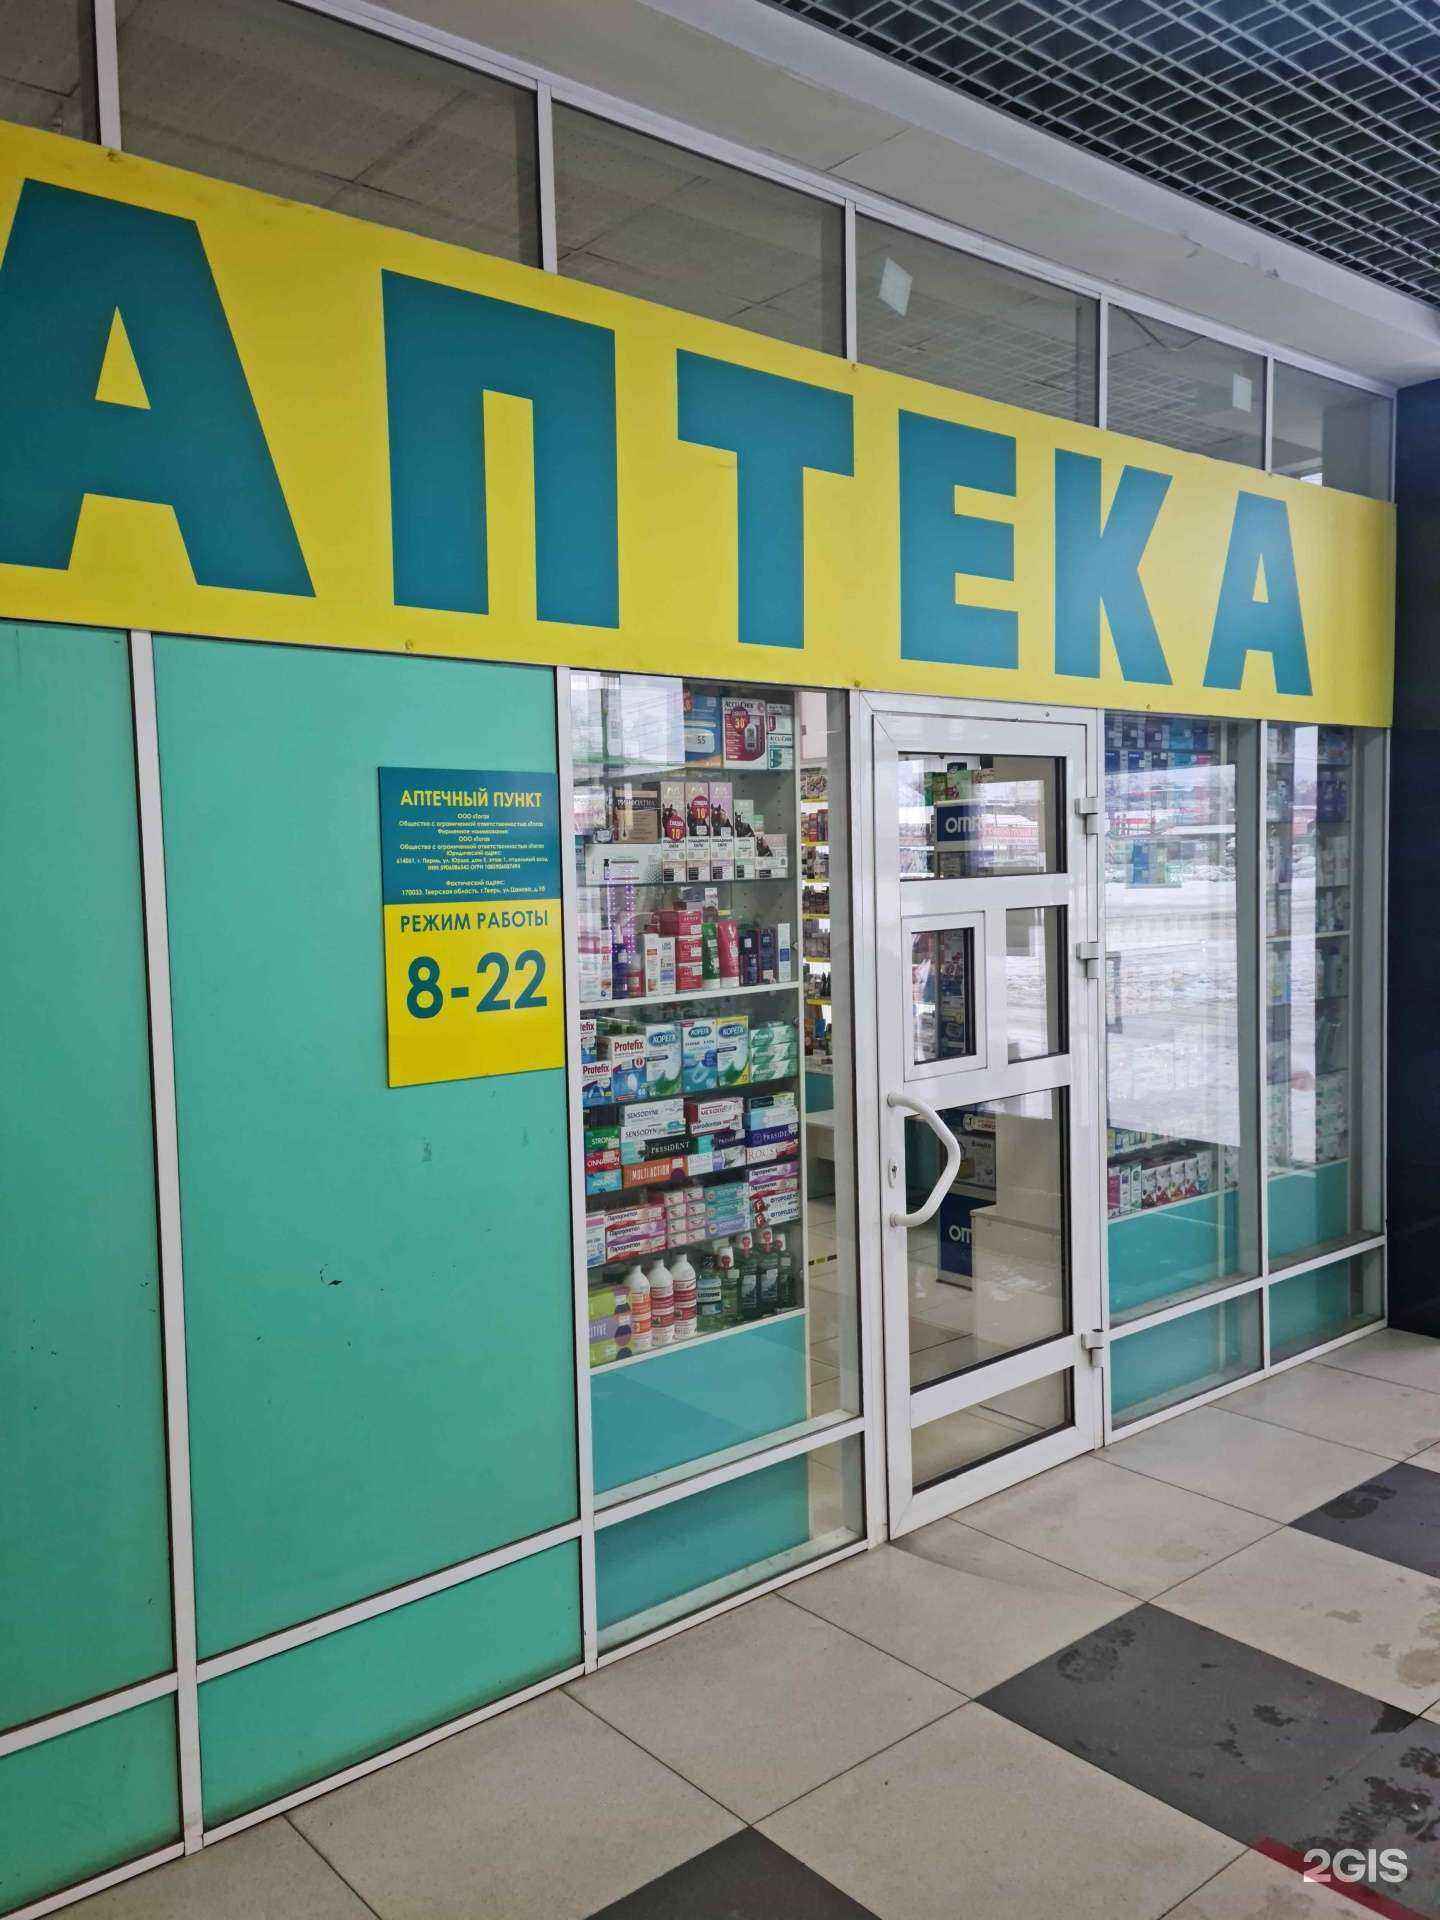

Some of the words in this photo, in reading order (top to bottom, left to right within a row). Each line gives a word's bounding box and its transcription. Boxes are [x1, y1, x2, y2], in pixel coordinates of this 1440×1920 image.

[0, 177, 1313, 697] АПТЕКА
[400, 787, 488, 807] АПТЕЧНЫЙ
[493, 791, 543, 808] ПУНКТ
[400, 911, 471, 933] РЕЖИМ
[476, 909, 549, 929] РАБОТЫ
[406, 949, 548, 1019] 8-22
[614, 1040, 644, 1052] Protefix
[582, 1064, 610, 1075] Protefix
